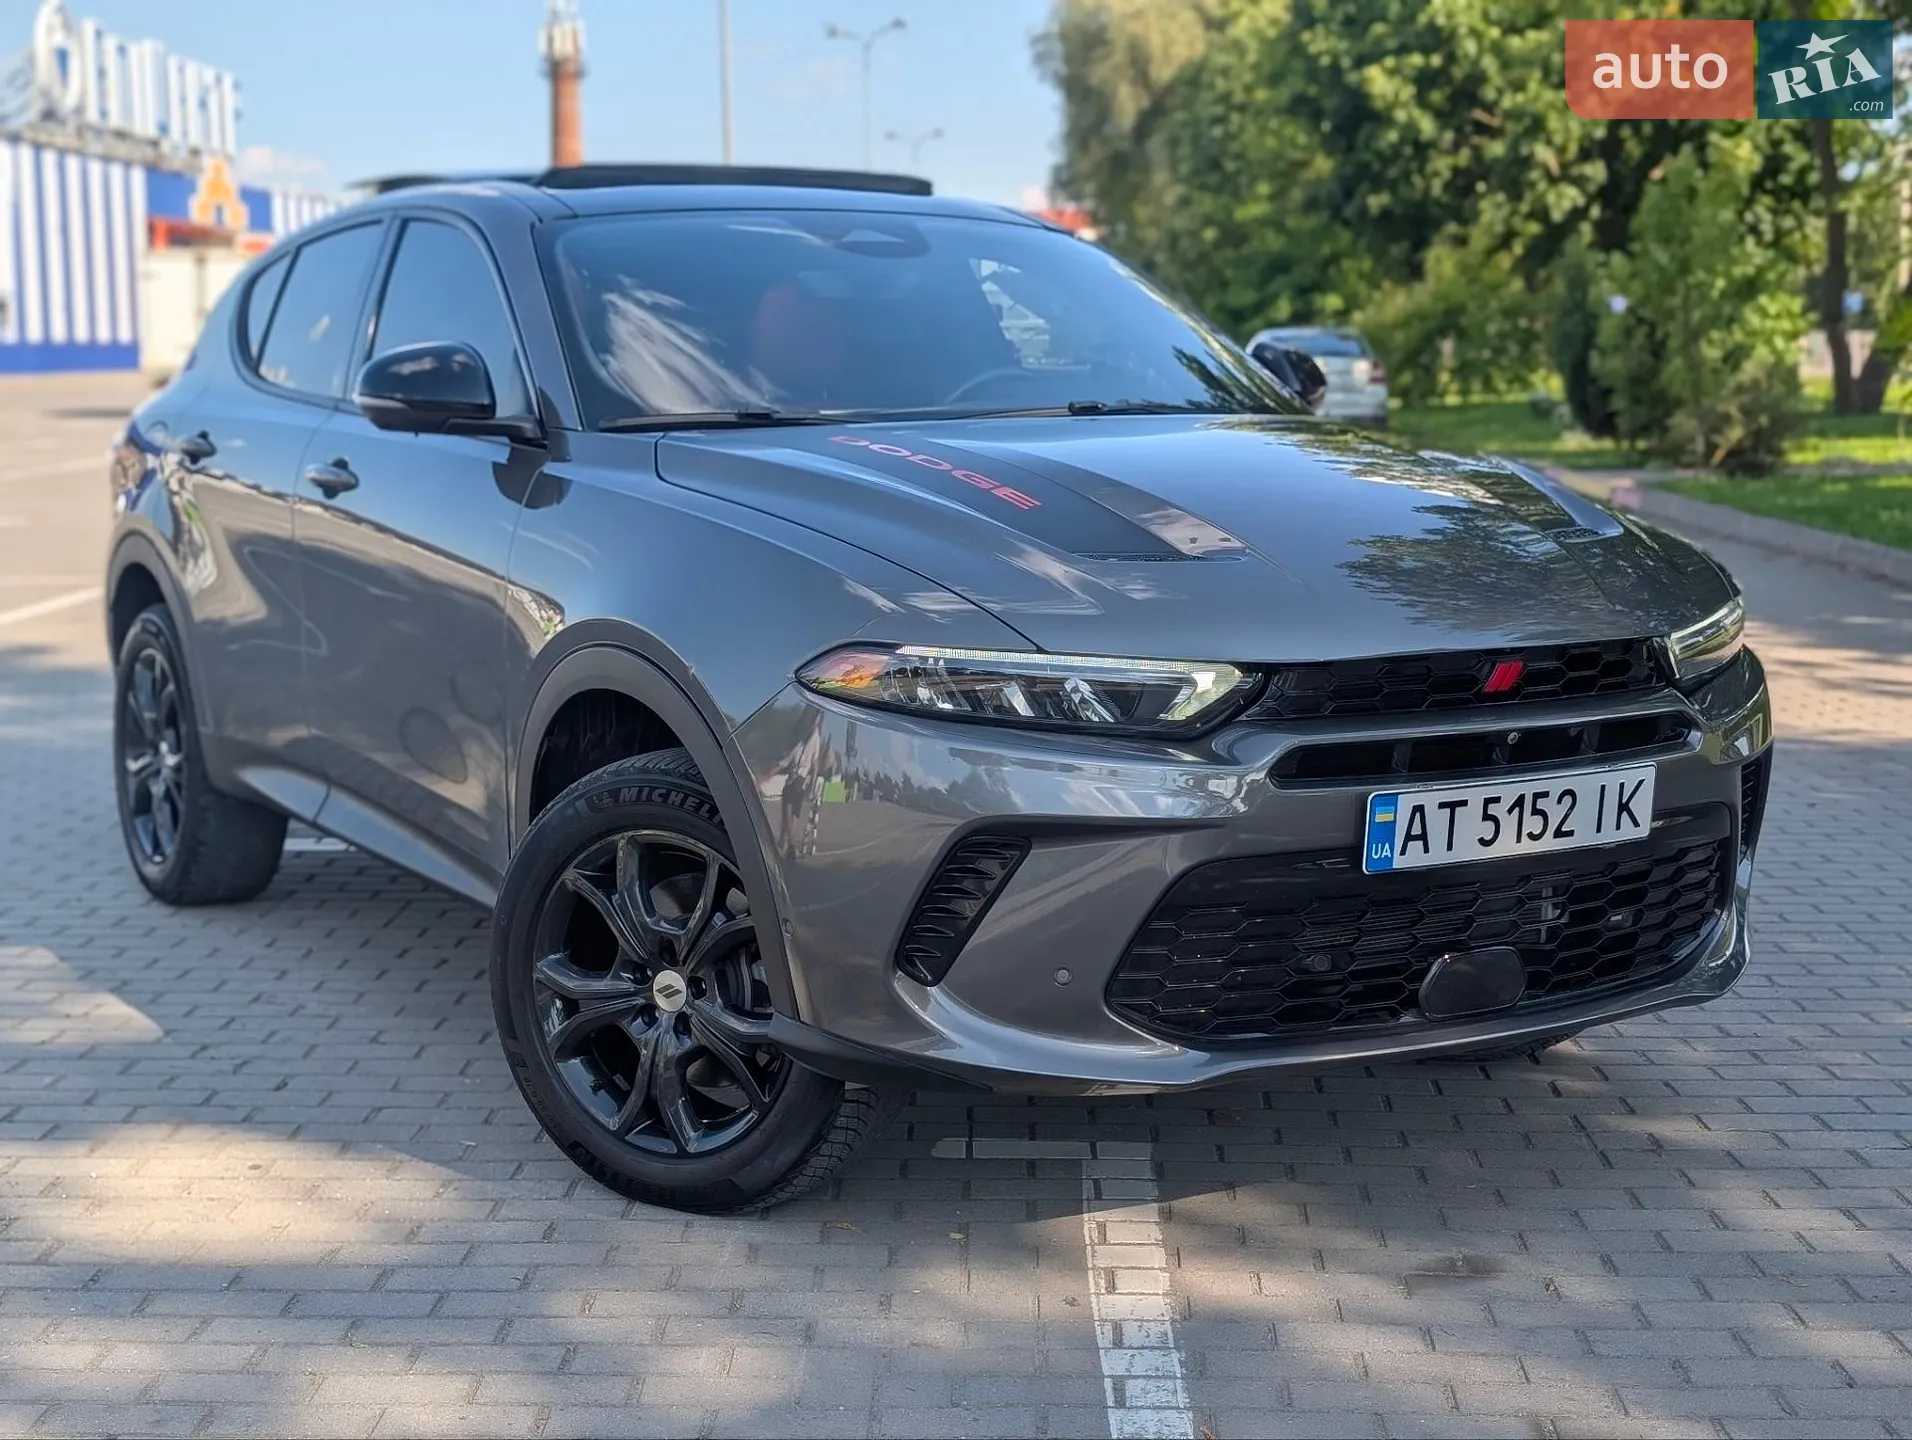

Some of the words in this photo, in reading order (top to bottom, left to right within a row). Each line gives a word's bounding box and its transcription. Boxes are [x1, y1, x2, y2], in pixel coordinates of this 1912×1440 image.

[828, 436, 1042, 510] DODGE
[619, 787, 723, 823] MICHELI
[1399, 799, 1468, 856] AT
[1477, 789, 1577, 848] 5152
[1596, 778, 1646, 833] IK
[1371, 843, 1391, 859] UA
